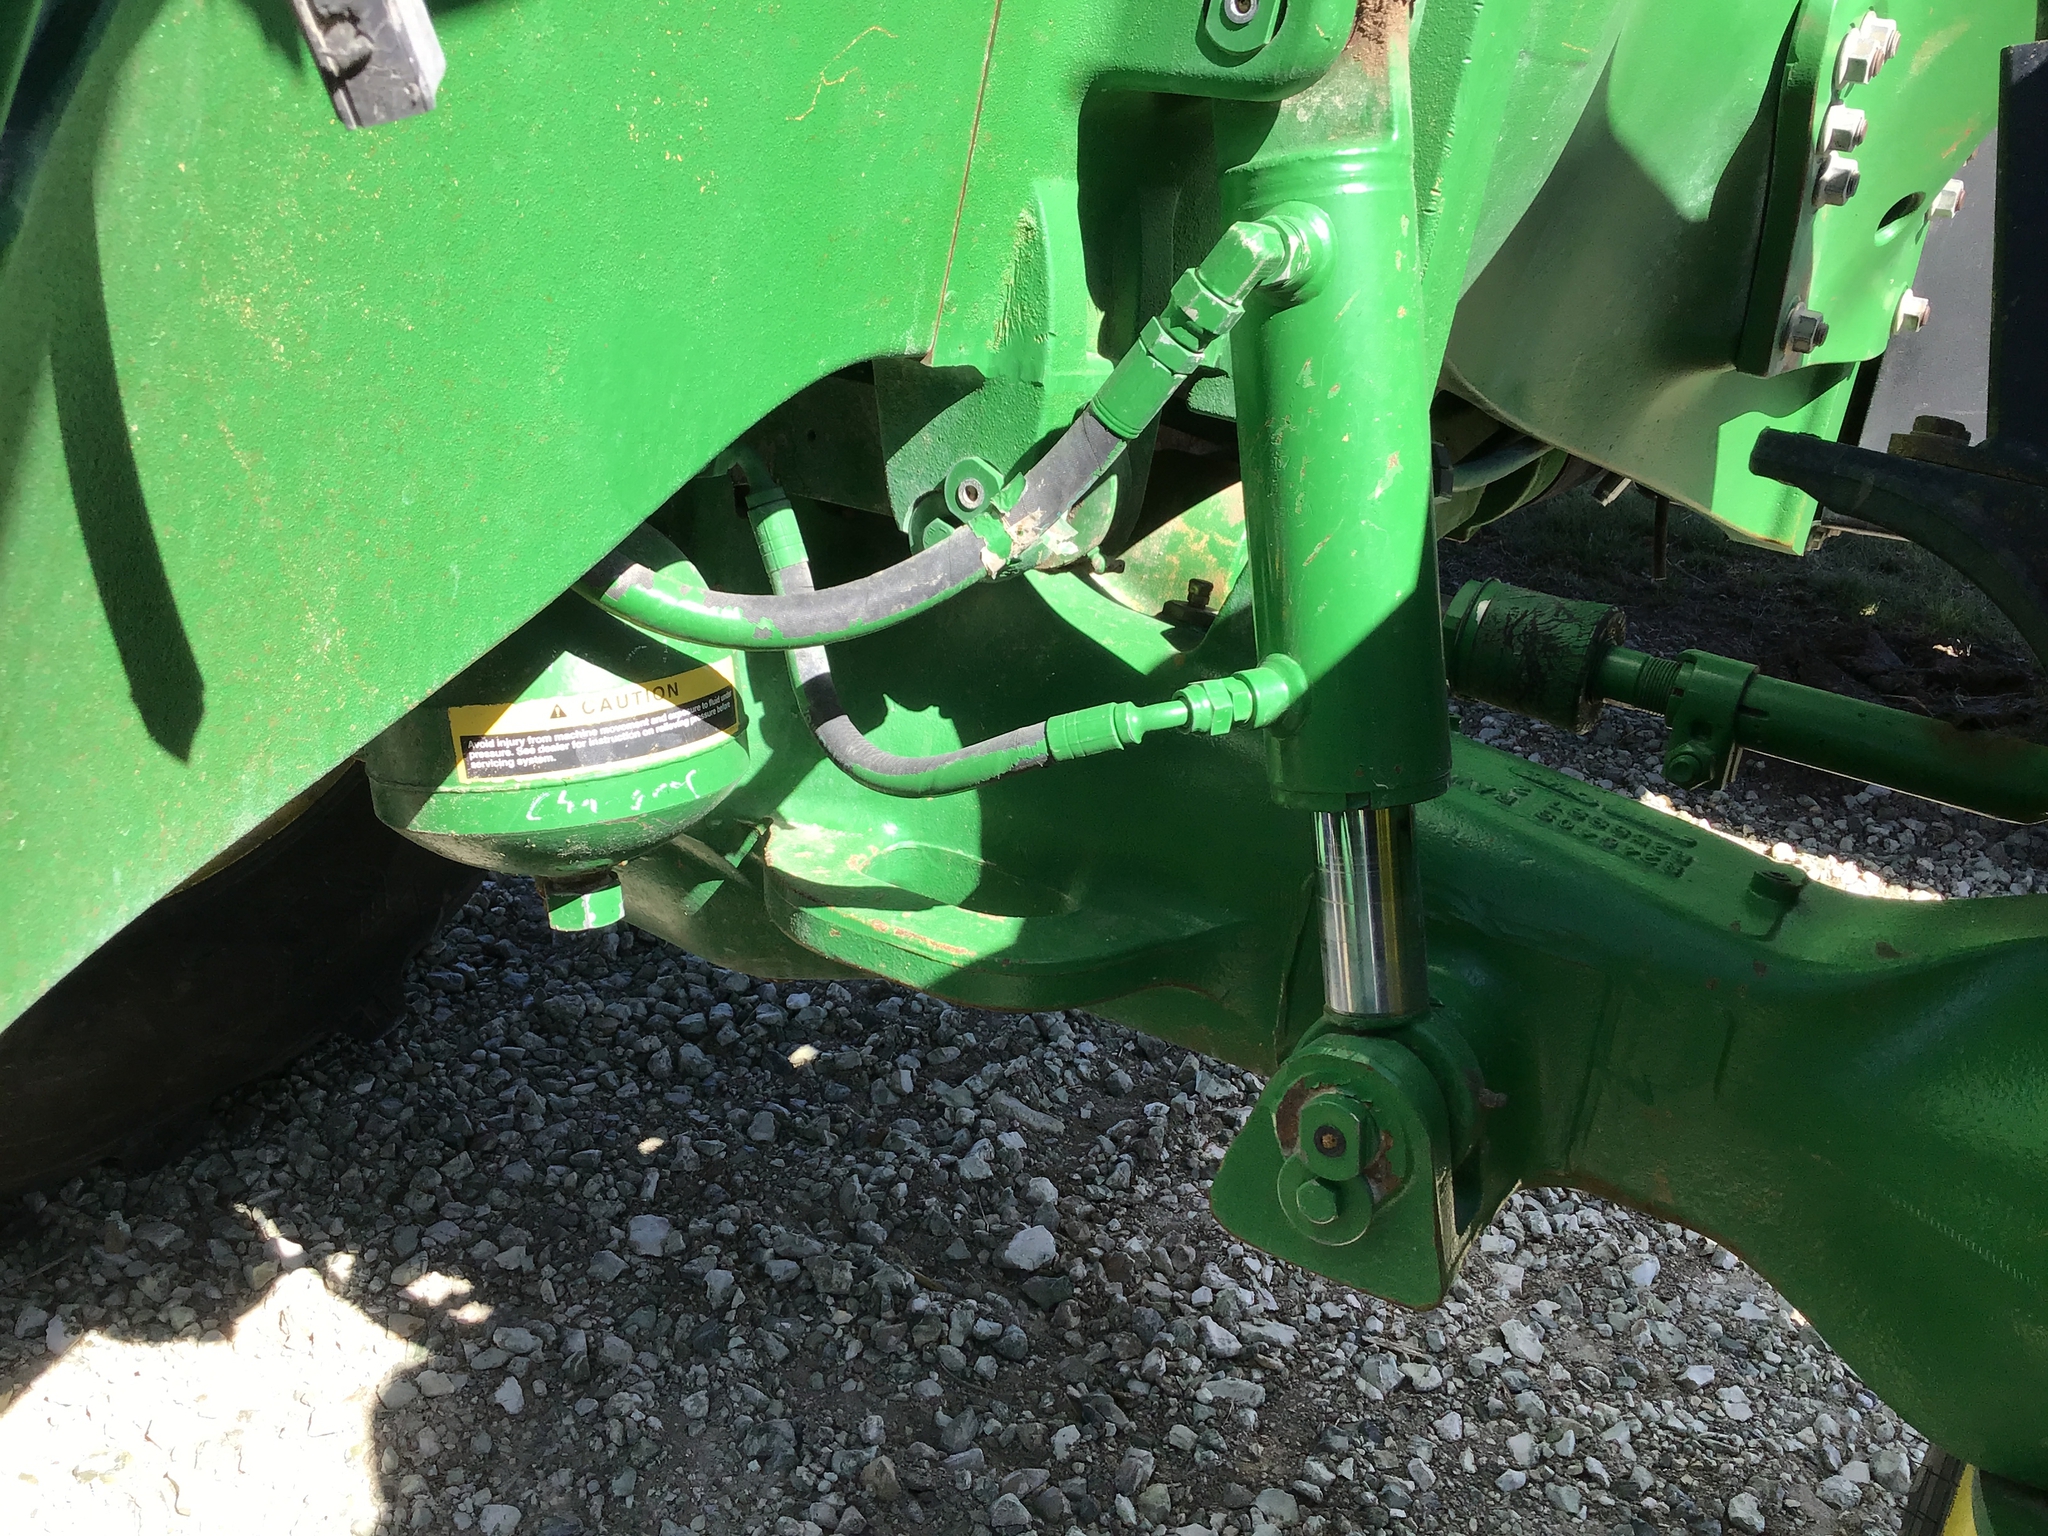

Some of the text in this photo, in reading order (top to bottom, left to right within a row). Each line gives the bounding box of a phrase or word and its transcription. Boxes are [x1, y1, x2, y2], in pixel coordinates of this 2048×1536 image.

[582, 682, 679, 715] CAUTION
[468, 737, 495, 749] Avoid
[496, 735, 526, 749] injury
[527, 735, 553, 745] from
[554, 729, 598, 742] machine
[599, 718, 650, 734] movement
[650, 713, 668, 725] and
[701, 701, 708, 710] to
[708, 695, 721, 708] fluid
[468, 748, 515, 761] pressure.
[515, 745, 536, 756] See
[537, 742, 570, 754] dealer
[571, 739, 588, 750] for
[588, 730, 641, 748] instruction
[641, 727, 655, 737] on
[655, 718, 690, 734] relieving
[470, 754, 557, 769] servicing system.
